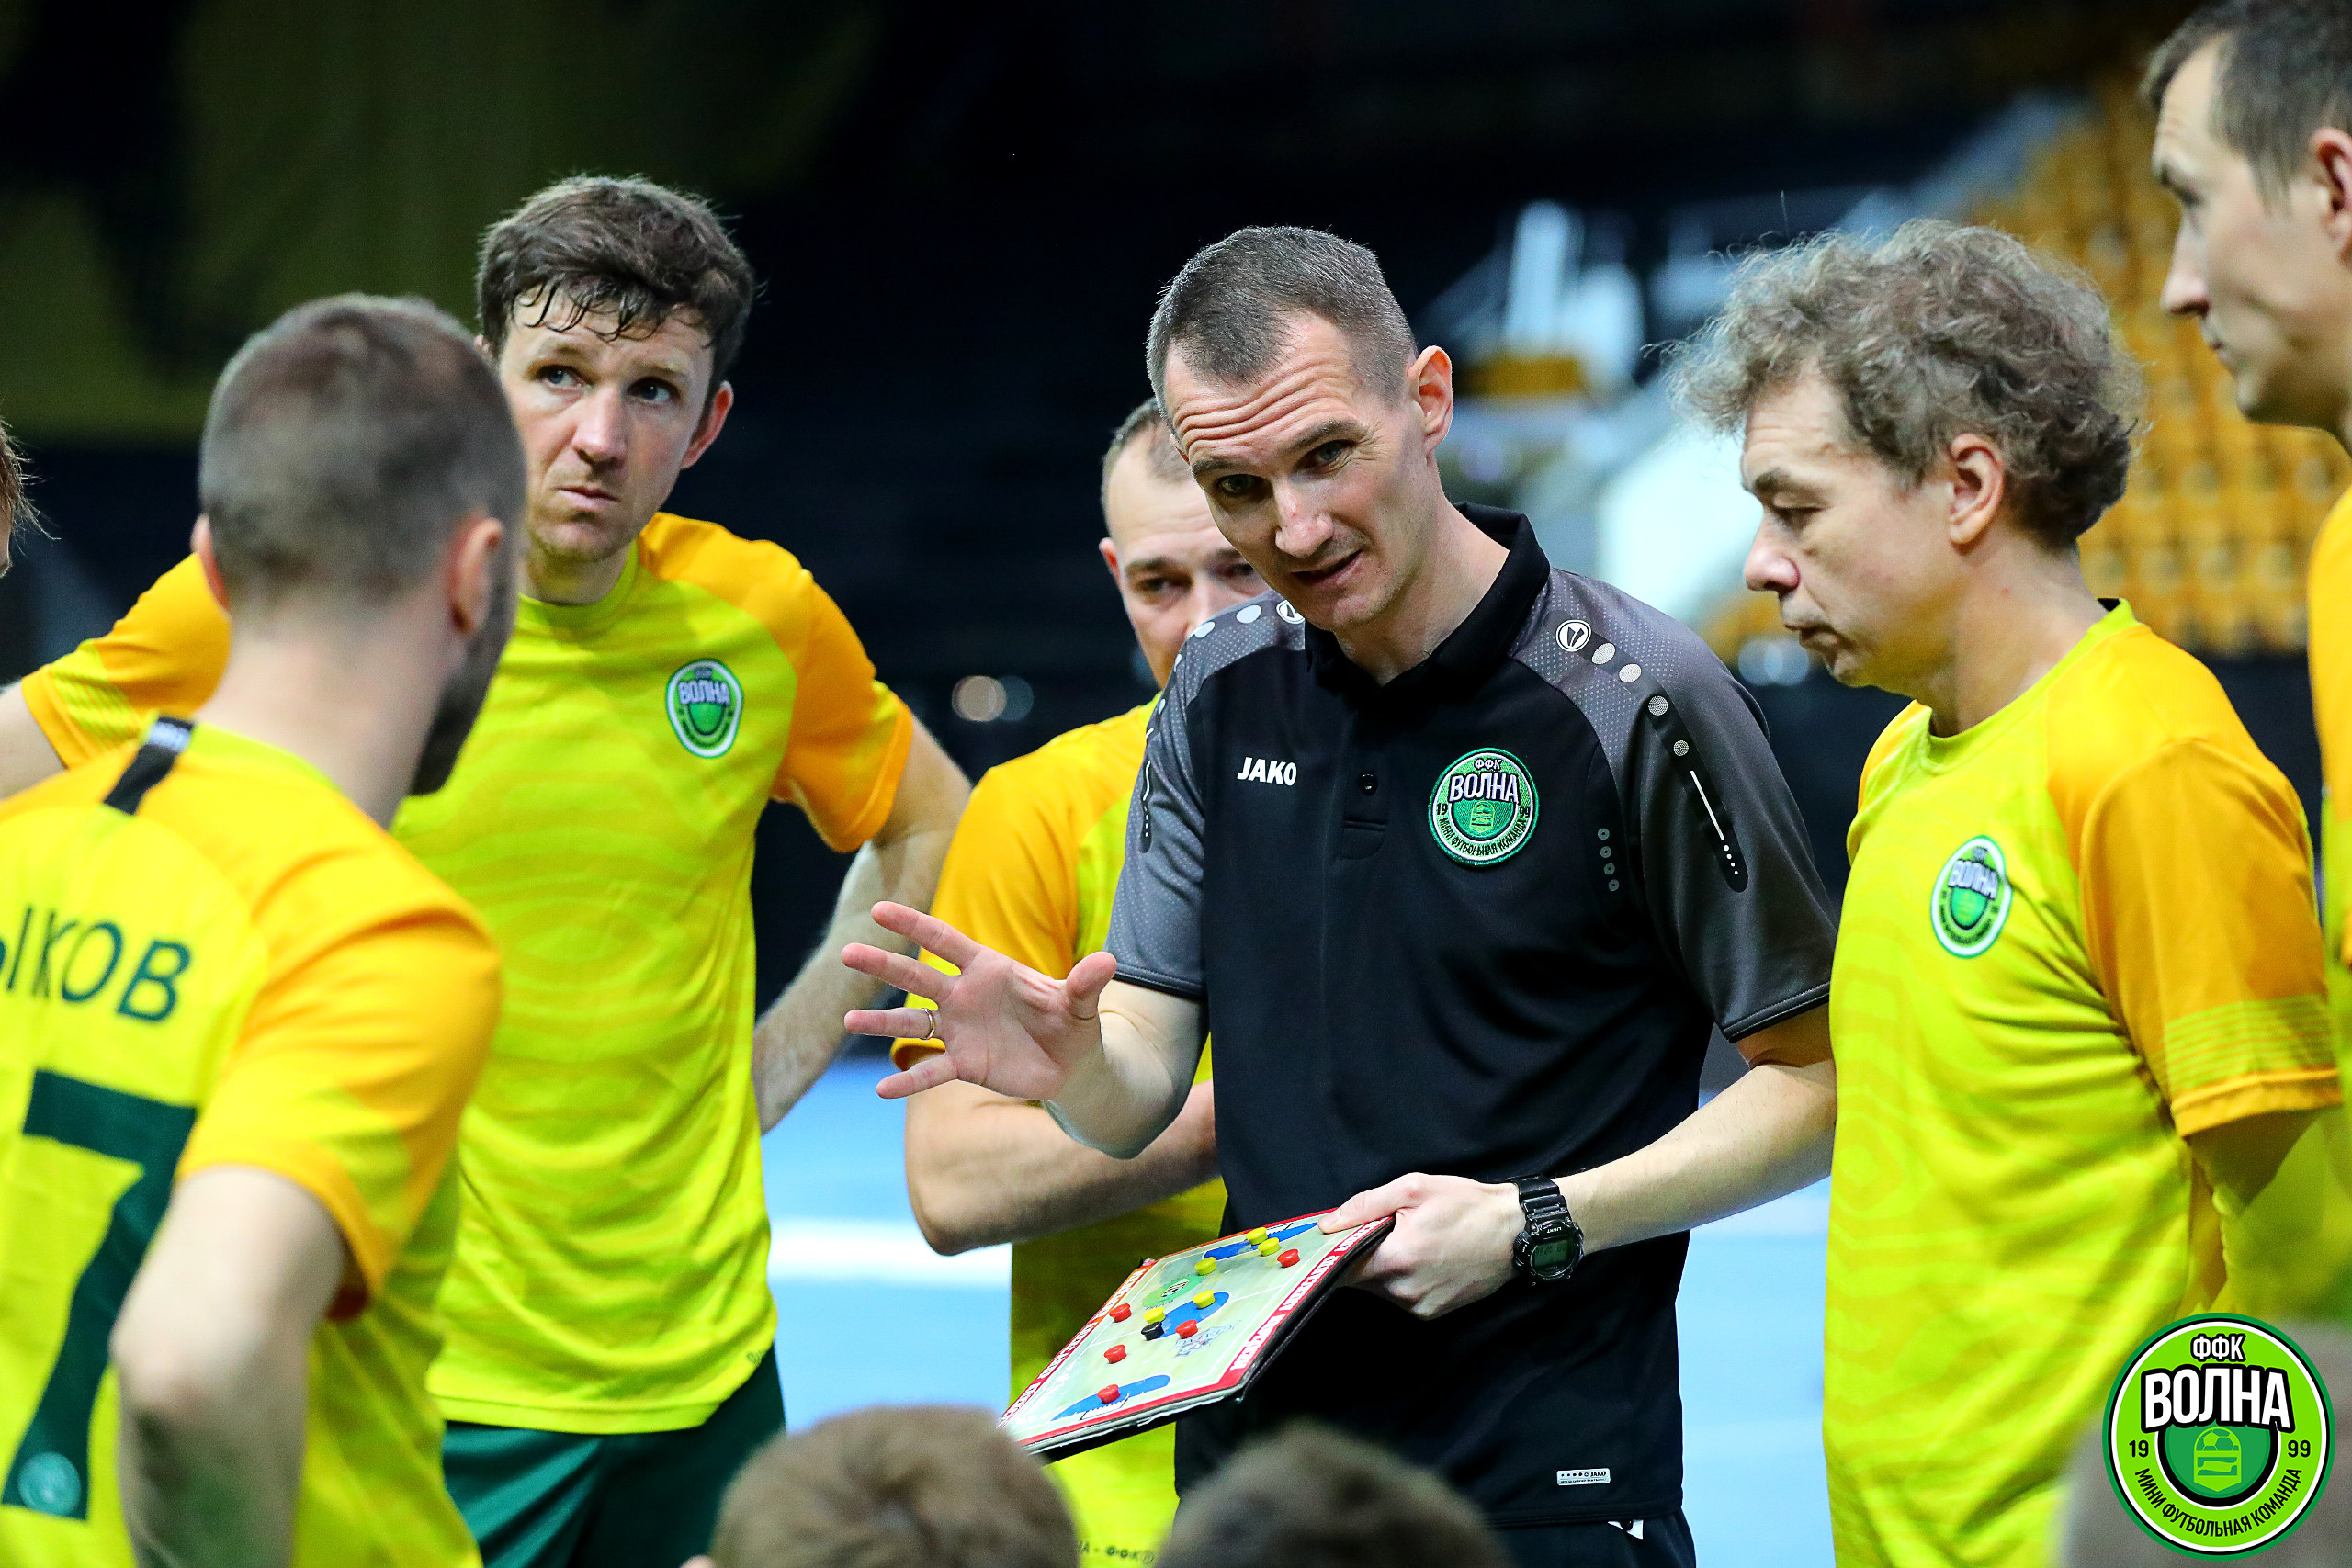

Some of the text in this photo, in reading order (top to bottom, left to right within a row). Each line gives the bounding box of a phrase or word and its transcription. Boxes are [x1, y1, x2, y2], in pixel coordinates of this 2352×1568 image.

[679, 680, 730, 705] ВОЛНА
[1237, 756, 1297, 786] JAKO
[1474, 759, 1502, 770] ФФК
[1449, 773, 1519, 803] ВОЛНА
[1436, 803, 1448, 816] 19
[1519, 807, 1531, 818] 99
[1439, 817, 1527, 855] МИНИ ФУТБОЛЬНАЯ КОМАНДА
